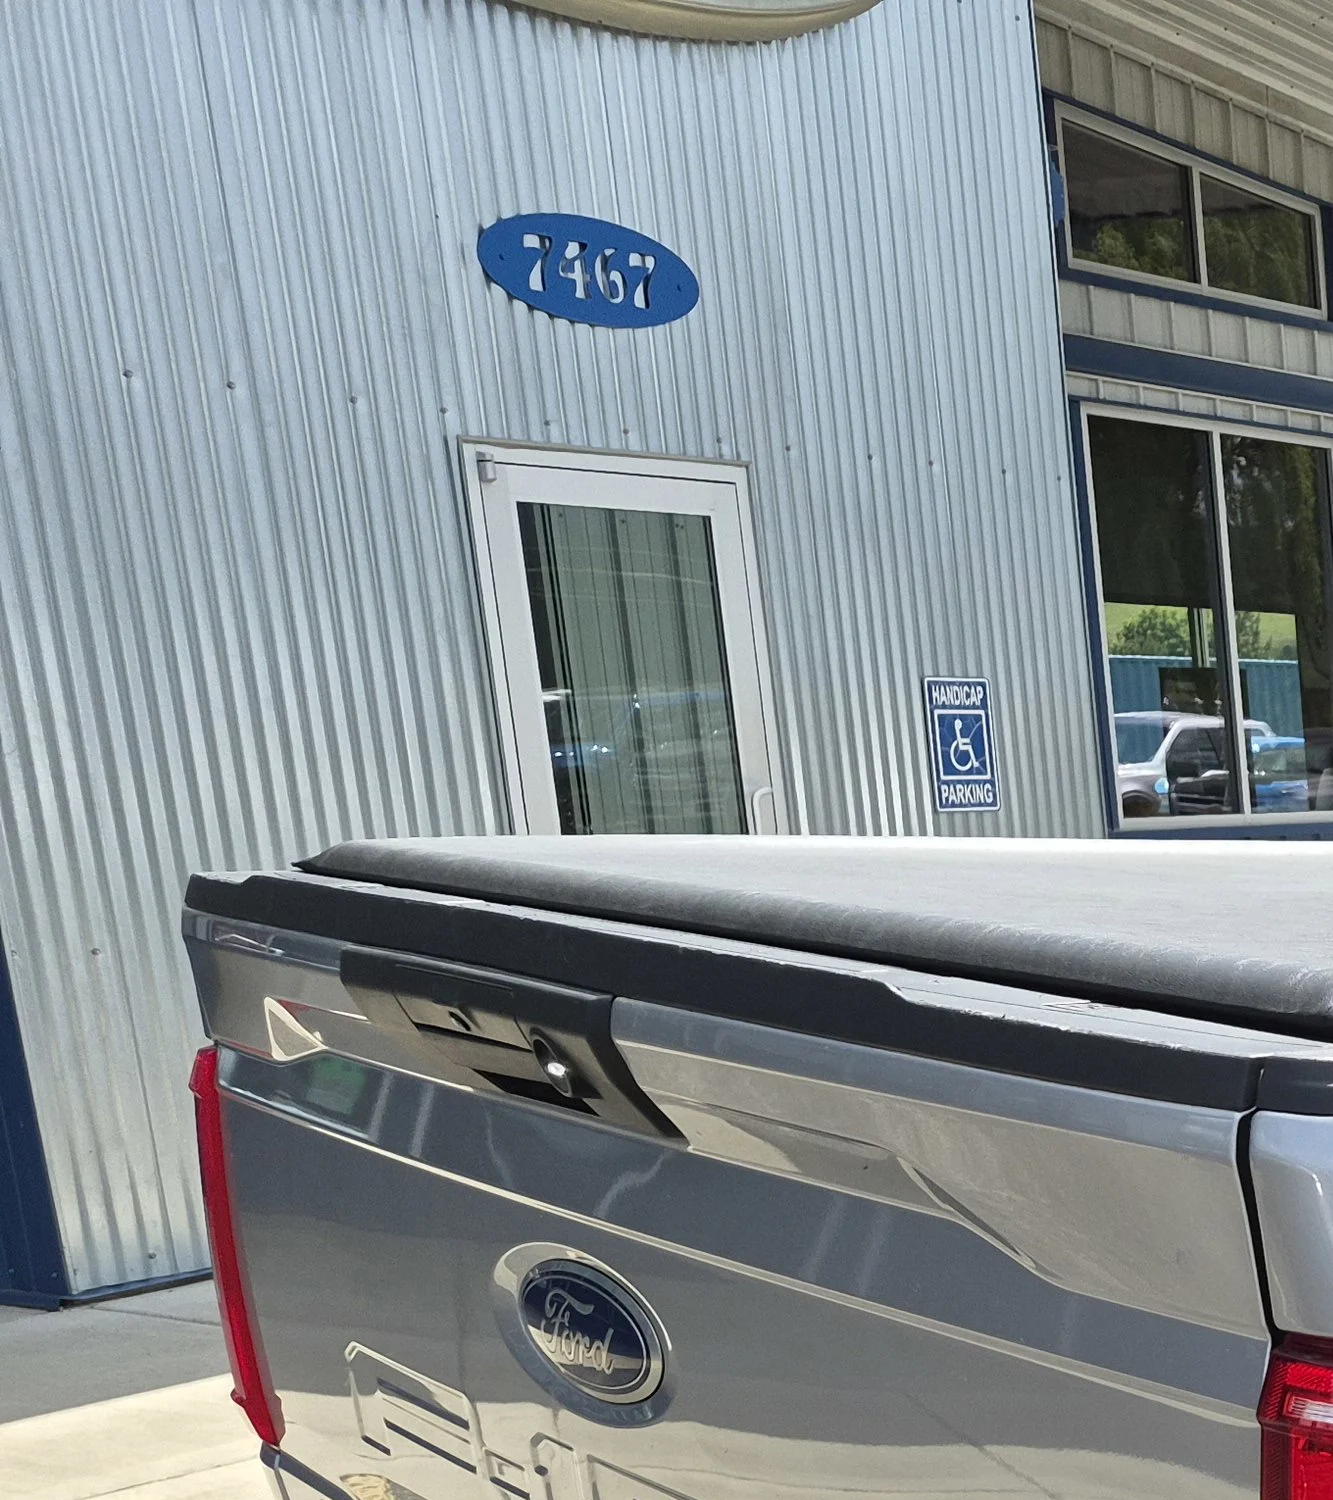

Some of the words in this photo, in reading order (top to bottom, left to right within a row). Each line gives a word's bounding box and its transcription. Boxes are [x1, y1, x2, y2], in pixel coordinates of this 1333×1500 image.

[523, 232, 656, 310] 7467
[932, 685, 984, 706] HANDICAP
[941, 783, 993, 804] PARKING
[541, 1288, 614, 1376] Ford
